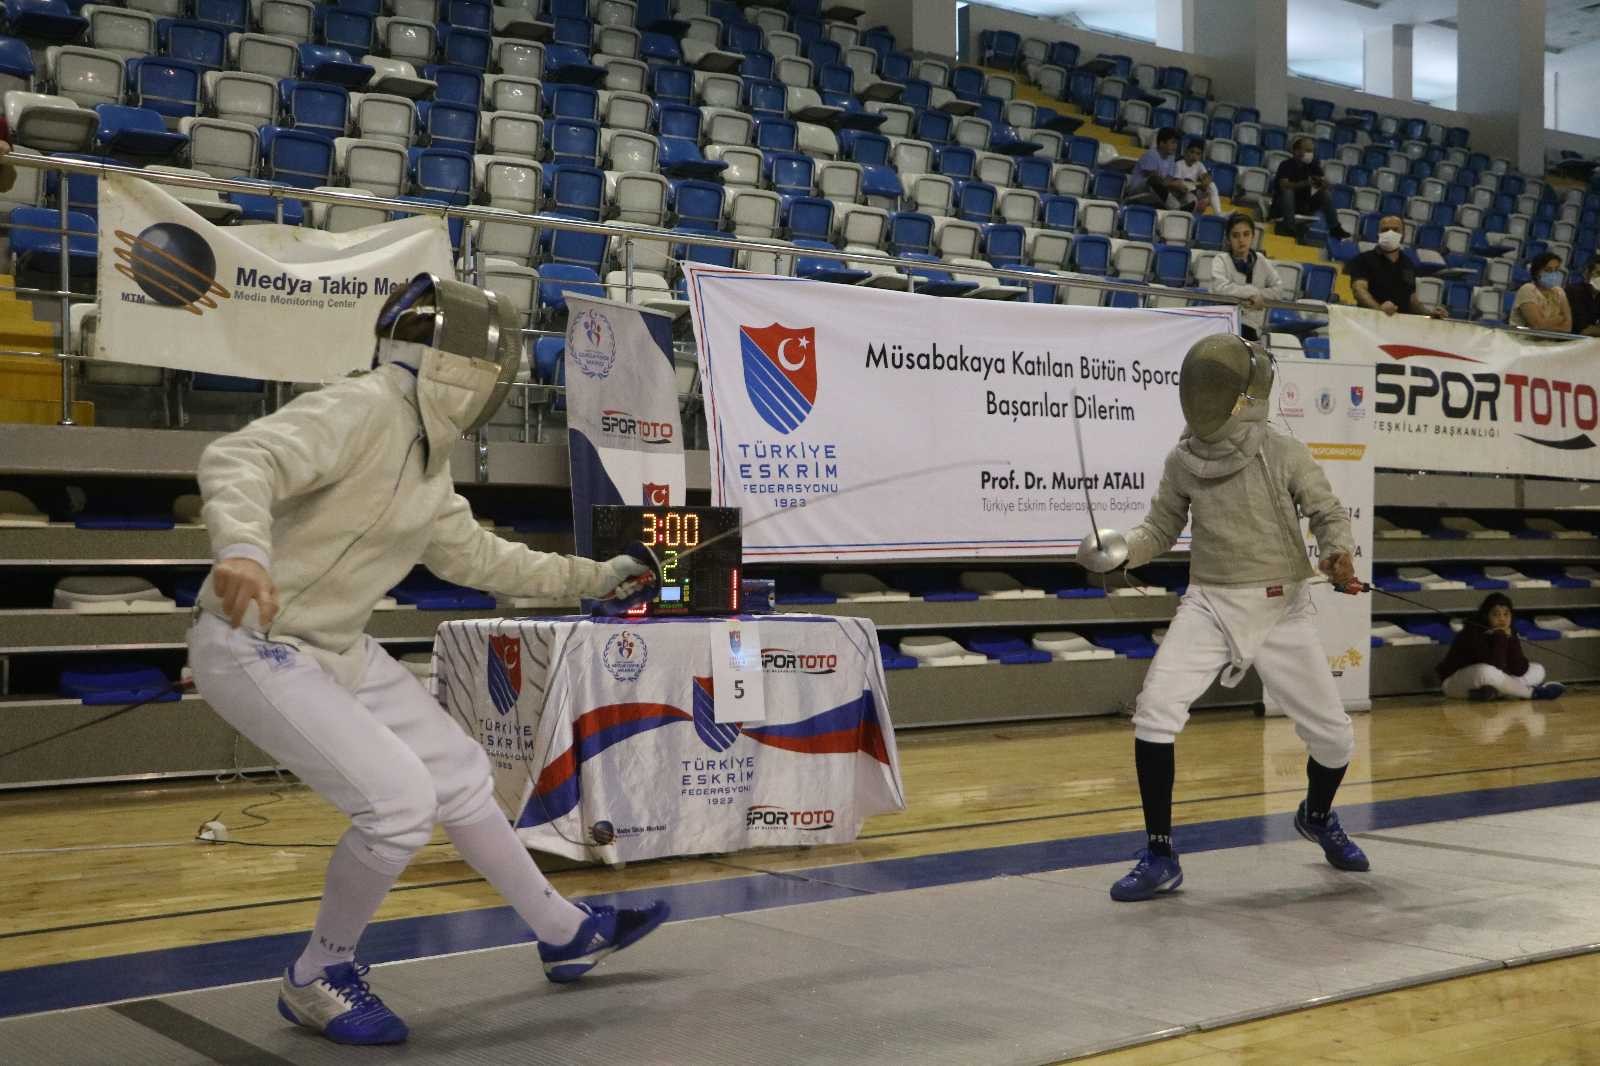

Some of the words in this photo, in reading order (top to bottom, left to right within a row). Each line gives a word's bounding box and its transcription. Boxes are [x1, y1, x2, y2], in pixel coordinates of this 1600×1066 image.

[236, 266, 312, 295] Medya
[318, 276, 368, 299] Takip
[121, 291, 146, 304] MTM
[234, 290, 267, 302] Media
[270, 294, 324, 309] Monitoring
[327, 298, 357, 309] Center
[865, 342, 1006, 381] Müsabakaya
[1012, 350, 1074, 379] Katılan
[1080, 356, 1126, 382] Bütün
[1132, 360, 1180, 391] Sporc
[986, 390, 1069, 423] Başarılar
[1073, 394, 1135, 421] Dilerim
[738, 440, 837, 459] TÜRKİYE
[739, 461, 838, 479] ESKRİM
[743, 483, 838, 494] FEDERASYONU
[981, 470, 1019, 490] Prof.
[1024, 471, 1047, 490] Dr.
[1052, 472, 1099, 490] Murat
[1103, 472, 1144, 490] ATALI
[774, 498, 807, 508] 1923
[982, 498, 1015, 515] Türkiye
[1018, 499, 1047, 512] Eskrim
[642, 513, 699, 546] 3:00
[663, 550, 678, 583] 2
[734, 680, 745, 699] 5
[681, 756, 754, 772] TÜRKİYE
[682, 770, 753, 786] ESKRİM
